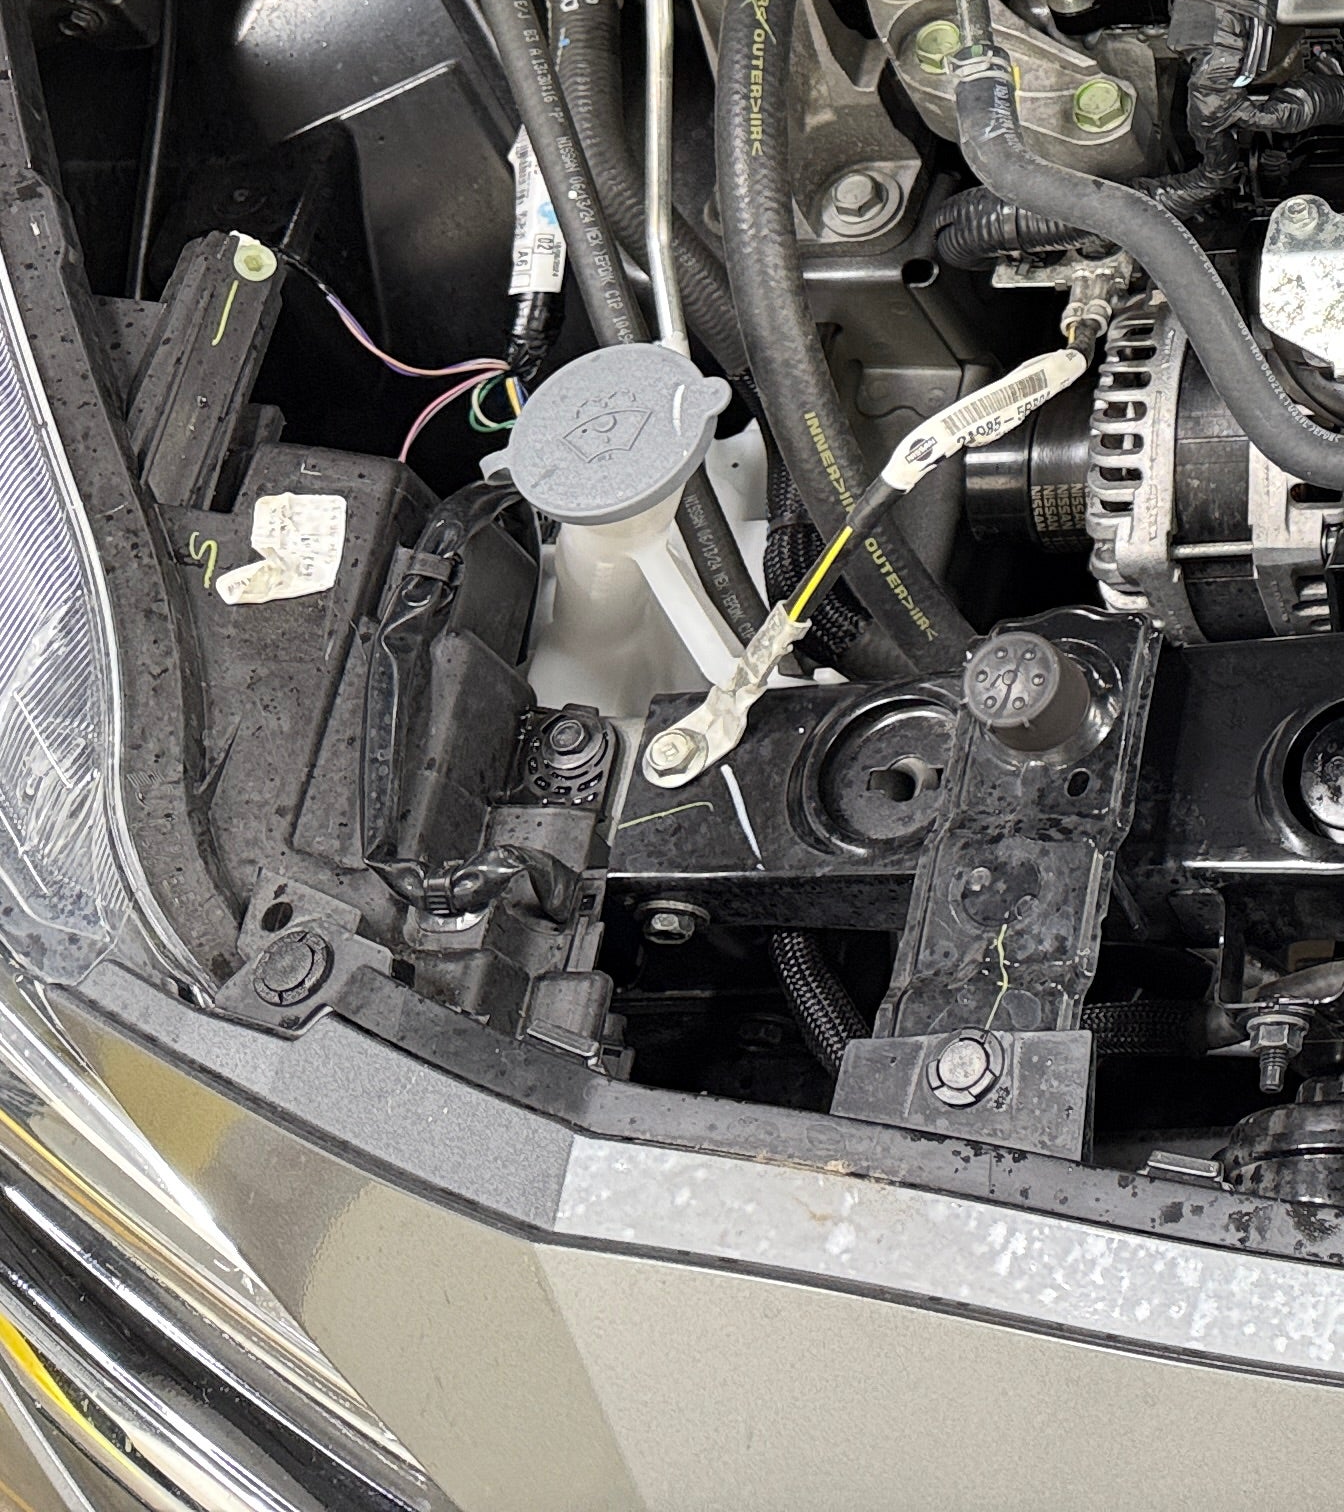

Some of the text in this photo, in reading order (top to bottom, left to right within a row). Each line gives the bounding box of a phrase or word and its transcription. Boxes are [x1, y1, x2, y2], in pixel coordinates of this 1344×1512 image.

[537, 238, 553, 252] 02
[1031, 485, 1047, 532] NISSAN
[1043, 485, 1060, 531] NISSAN
[1057, 485, 1074, 530] NISSAN
[1071, 483, 1086, 529] NISSAN
[864, 537, 938, 642] OUTER>IIR<
